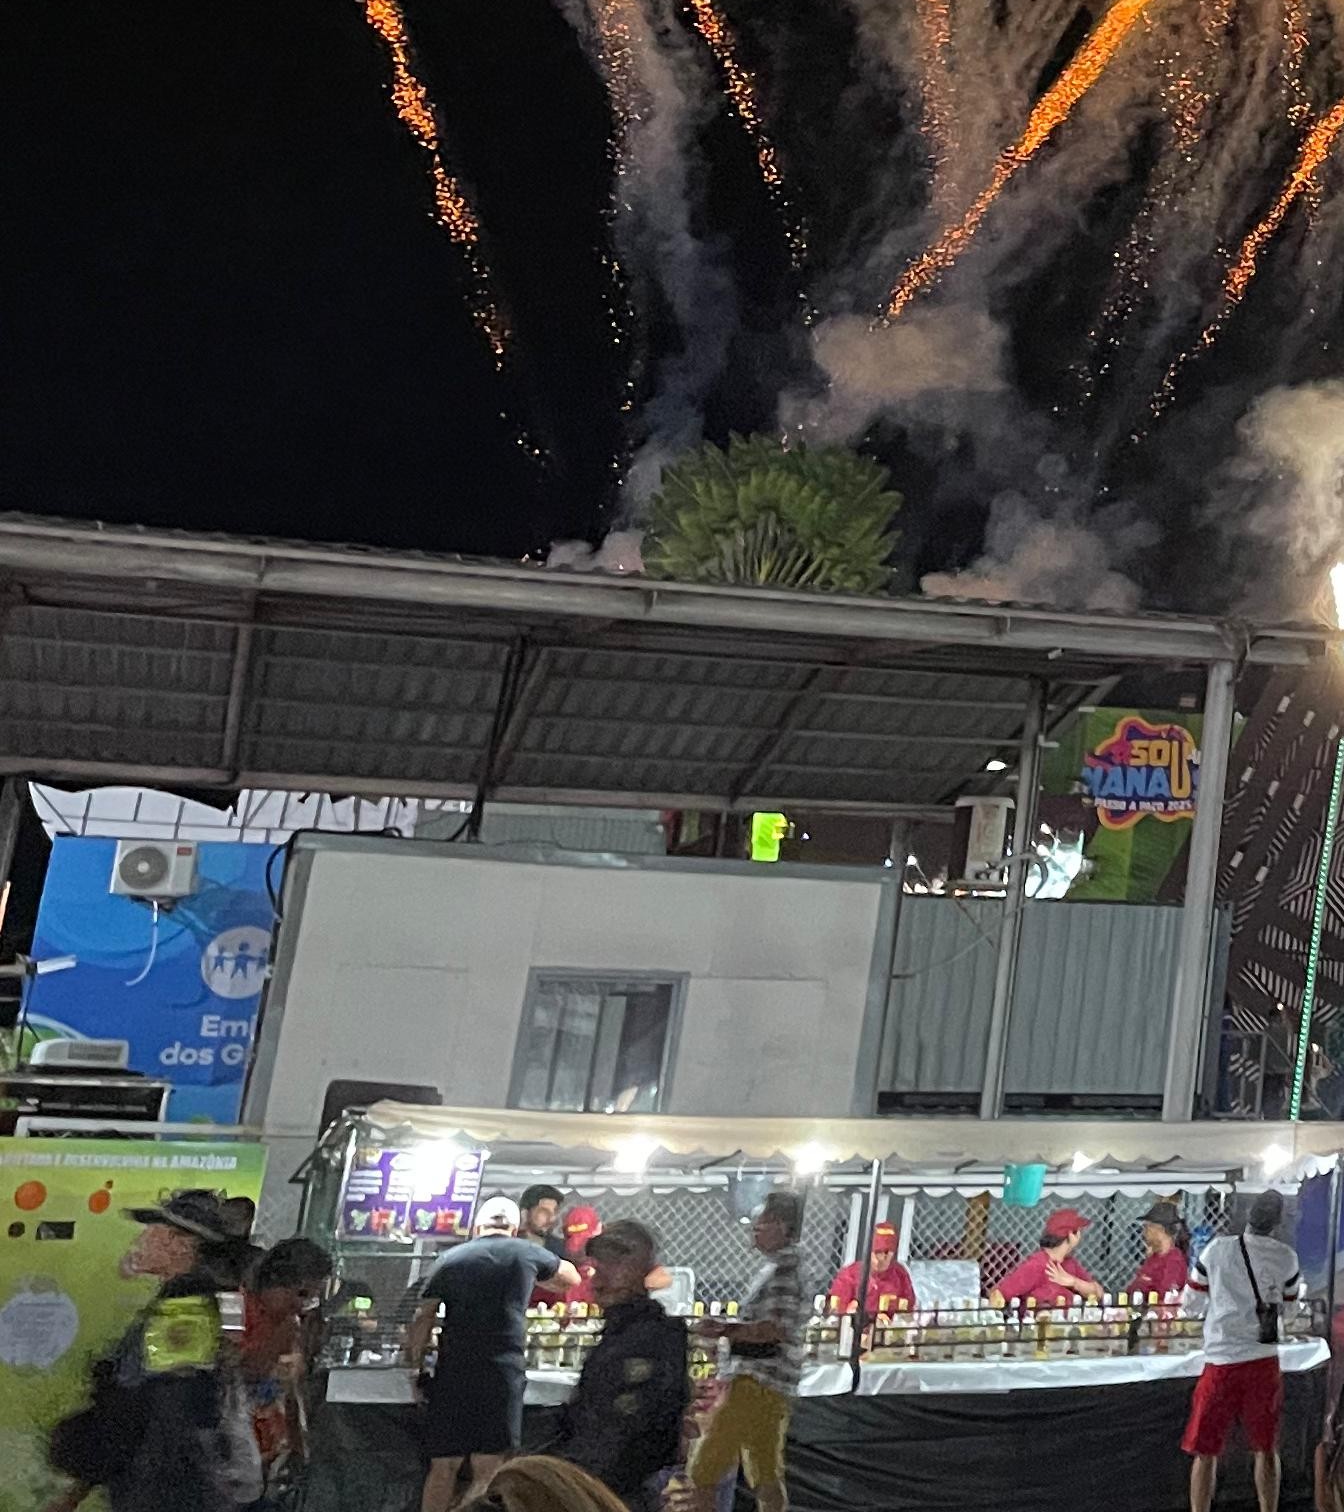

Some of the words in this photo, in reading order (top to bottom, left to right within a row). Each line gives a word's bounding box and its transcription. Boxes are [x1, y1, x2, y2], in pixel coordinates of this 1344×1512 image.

[1081, 767, 1198, 799] MANAU
[160, 1041, 215, 1065] dos
[221, 1044, 251, 1066] G
[171, 1153, 238, 1170] AMAZÔNIA
